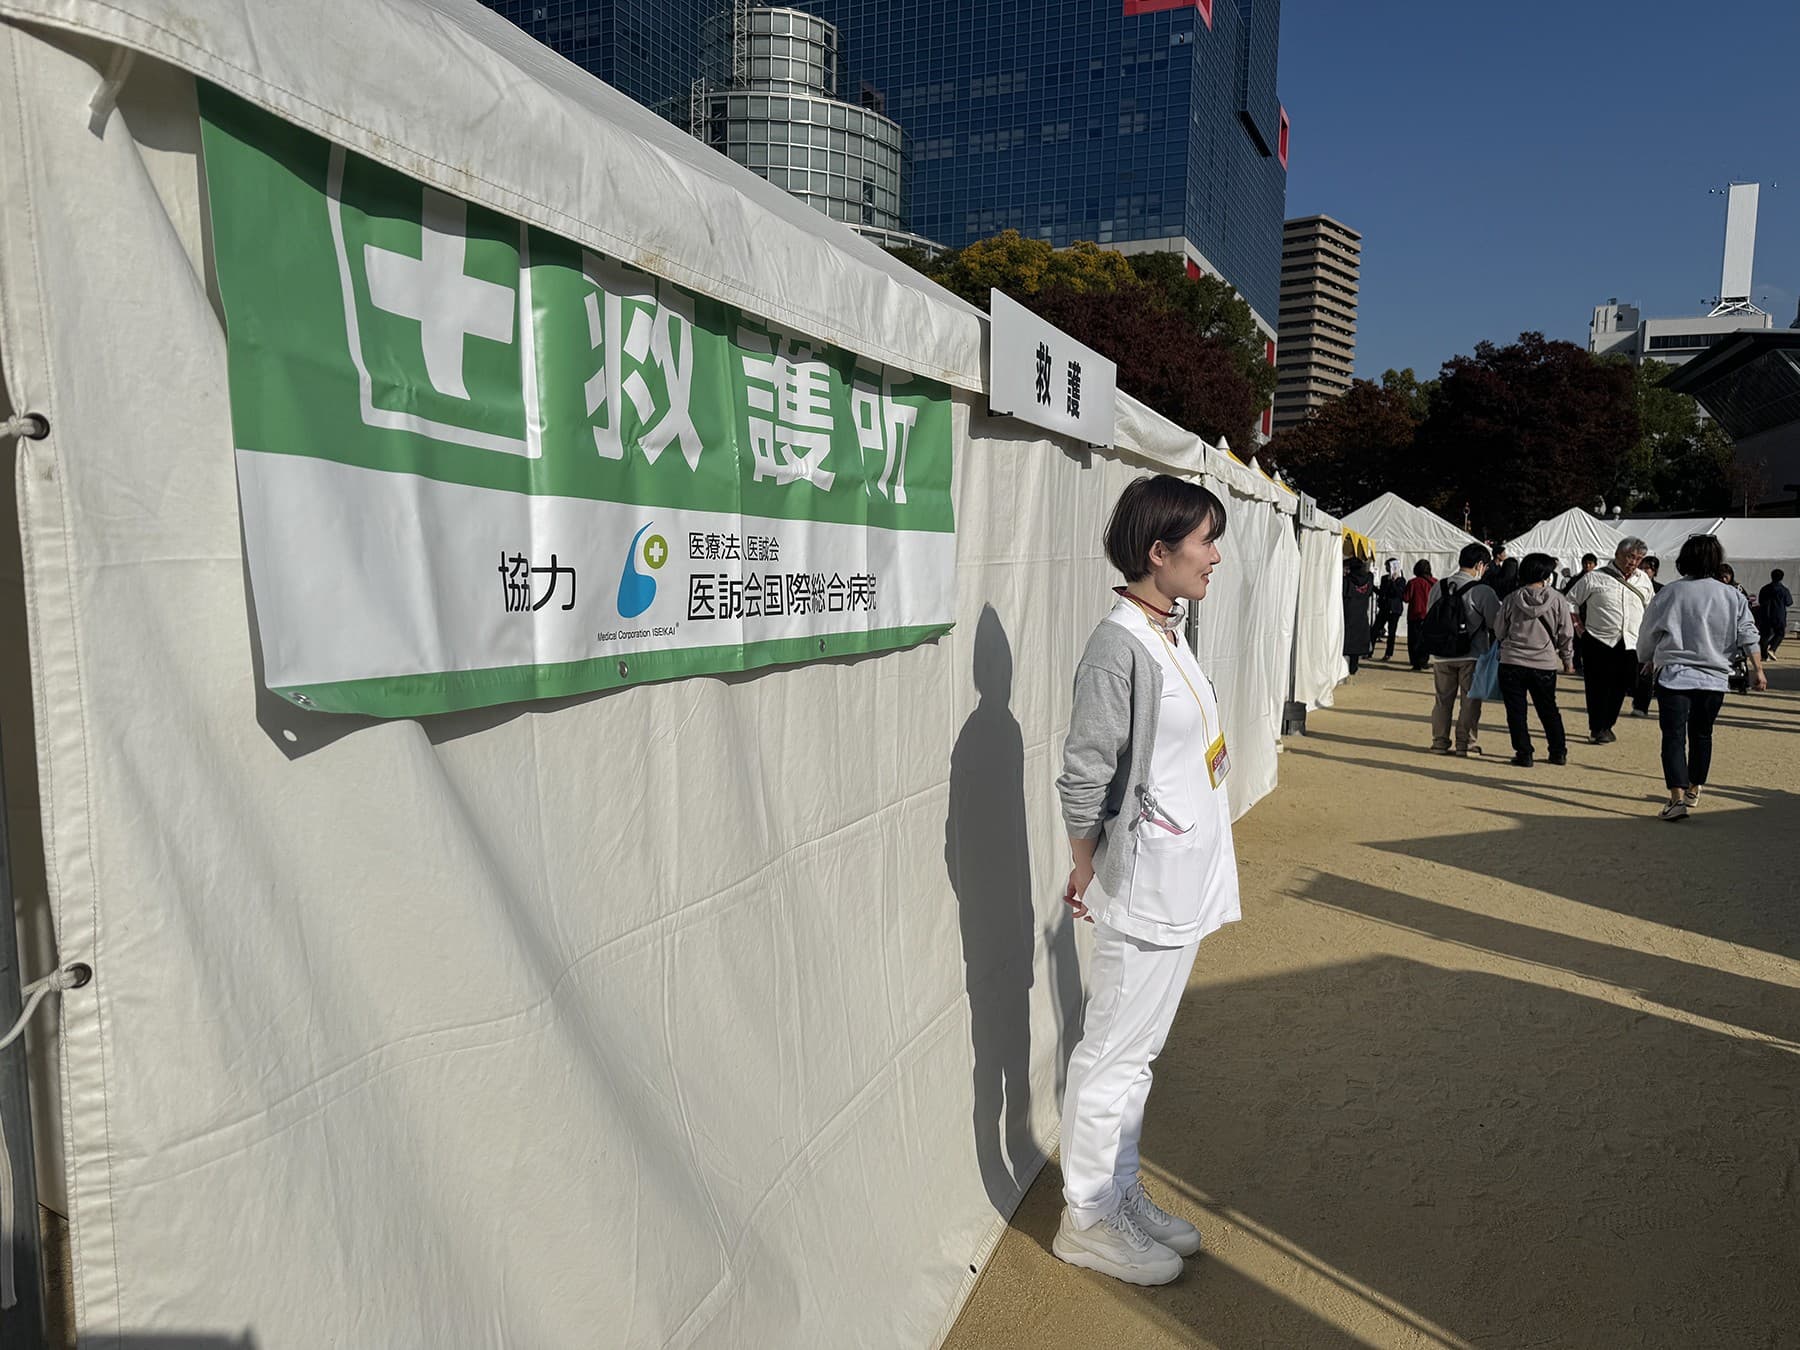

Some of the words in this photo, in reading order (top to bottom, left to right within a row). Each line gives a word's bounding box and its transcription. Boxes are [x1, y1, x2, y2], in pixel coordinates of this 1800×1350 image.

[582, 244, 918, 504] 救護所
[1035, 341, 1081, 419] 救護
[498, 551, 576, 612] 協力
[618, 629, 651, 640] Corporation
